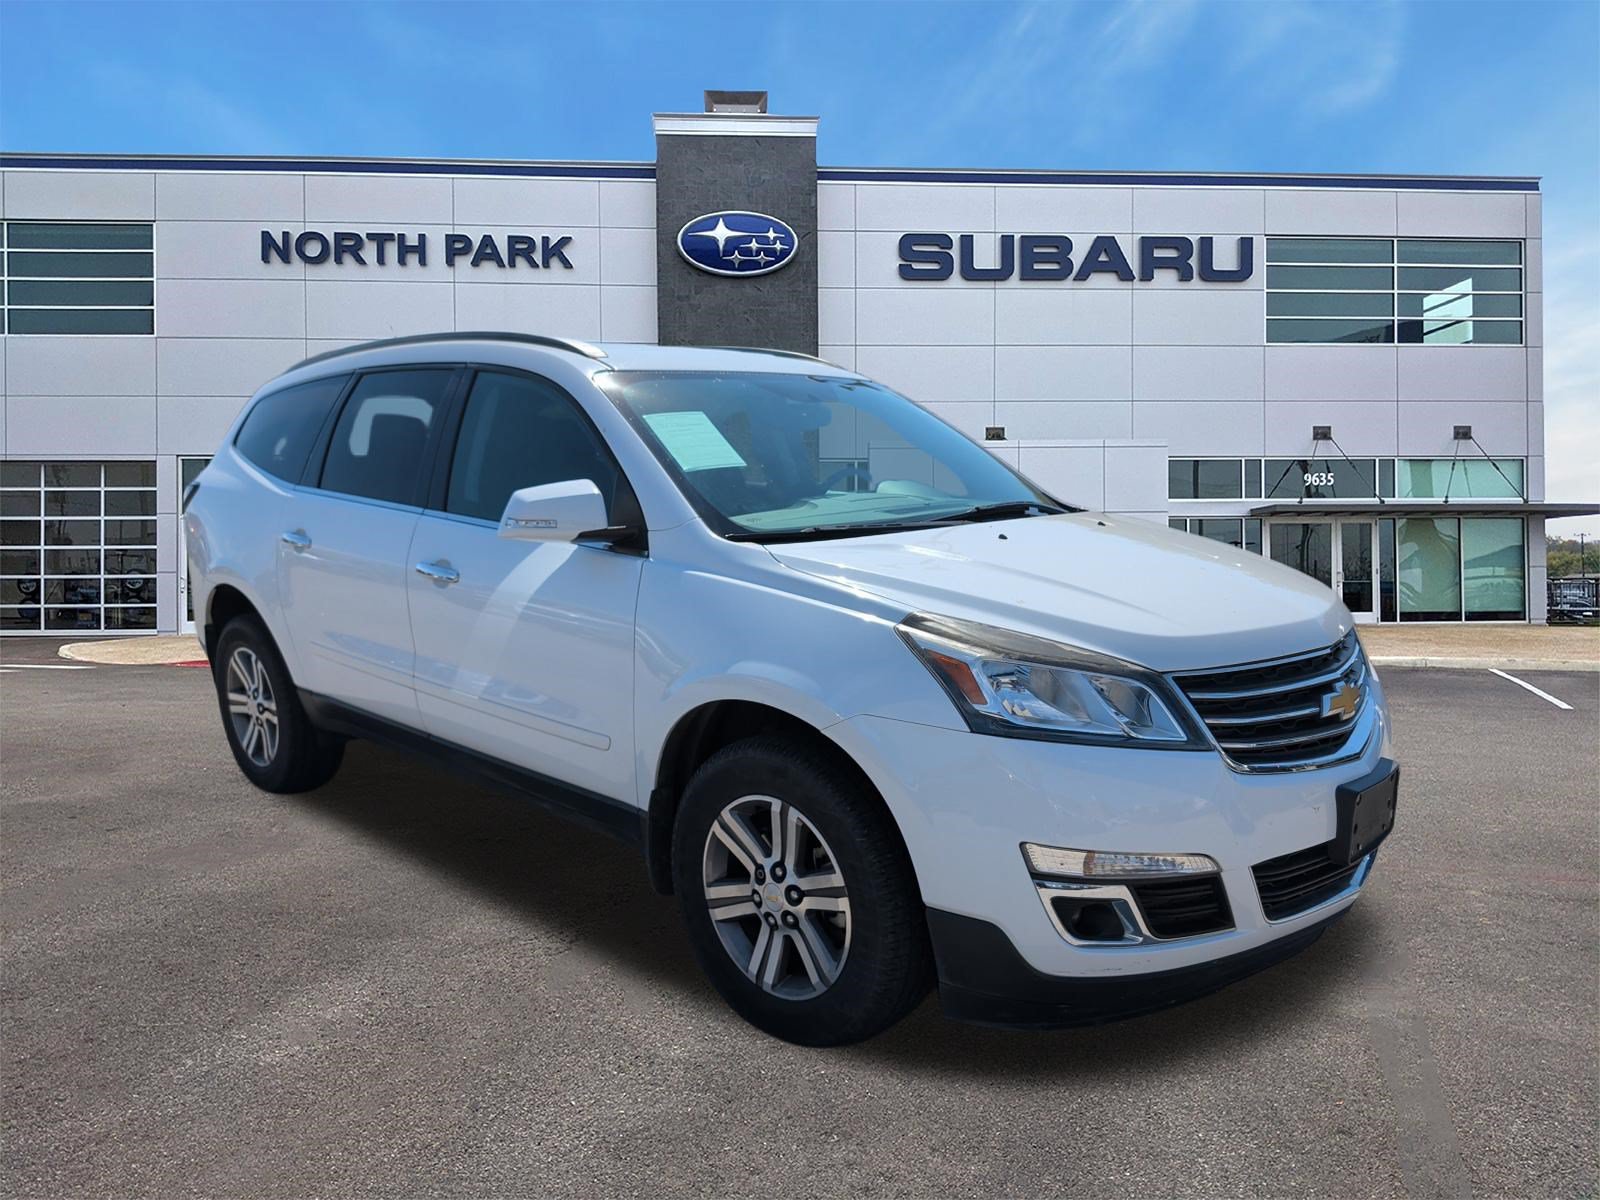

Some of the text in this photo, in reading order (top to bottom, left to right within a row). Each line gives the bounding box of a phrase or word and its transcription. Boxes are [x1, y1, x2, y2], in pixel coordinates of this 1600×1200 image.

[261, 230, 573, 268] NORTH PARK
[898, 233, 1253, 282] SUBARU
[1304, 473, 1334, 486] 9635
